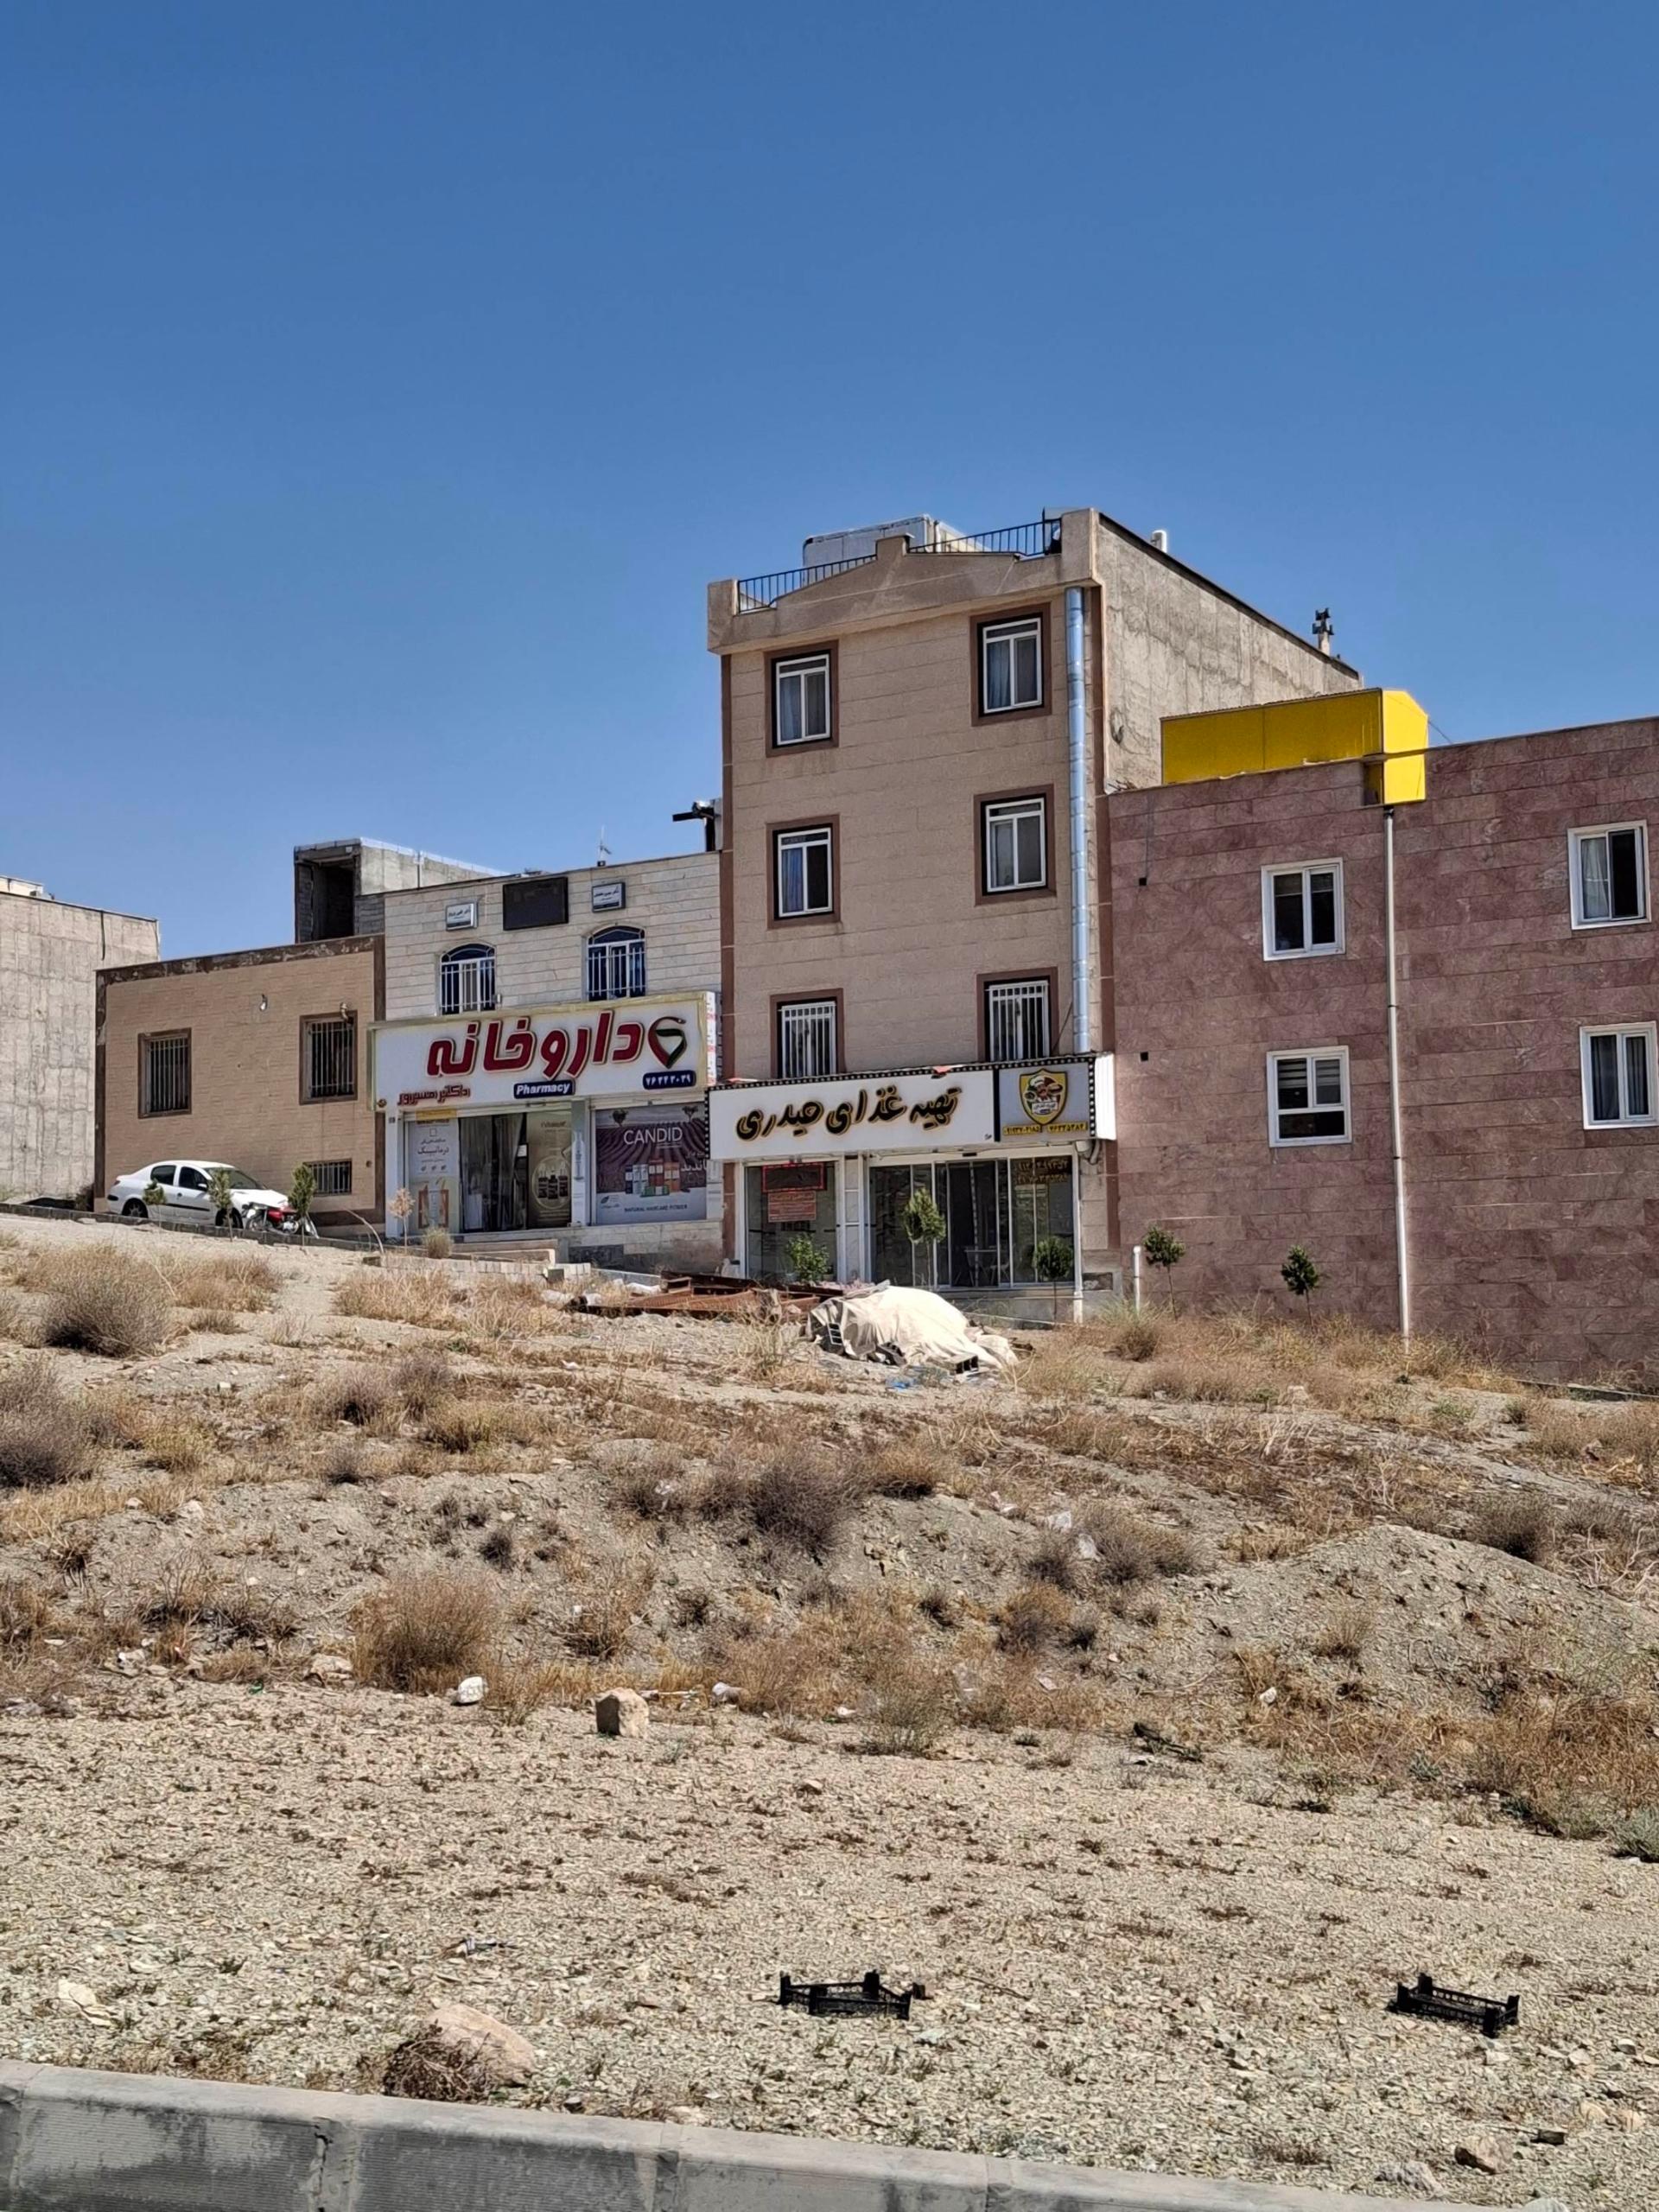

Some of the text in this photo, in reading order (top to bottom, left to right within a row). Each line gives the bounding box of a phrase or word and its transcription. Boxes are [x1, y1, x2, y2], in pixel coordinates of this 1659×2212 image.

[427, 1009, 644, 1079] داروخانه
[437, 1084, 471, 1103] دکتر
[516, 1082, 570, 1096] Pharmacy
[825, 1084, 906, 1136] غذای
[909, 1087, 963, 1131] تهیه
[623, 1127, 683, 1145] CANDID
